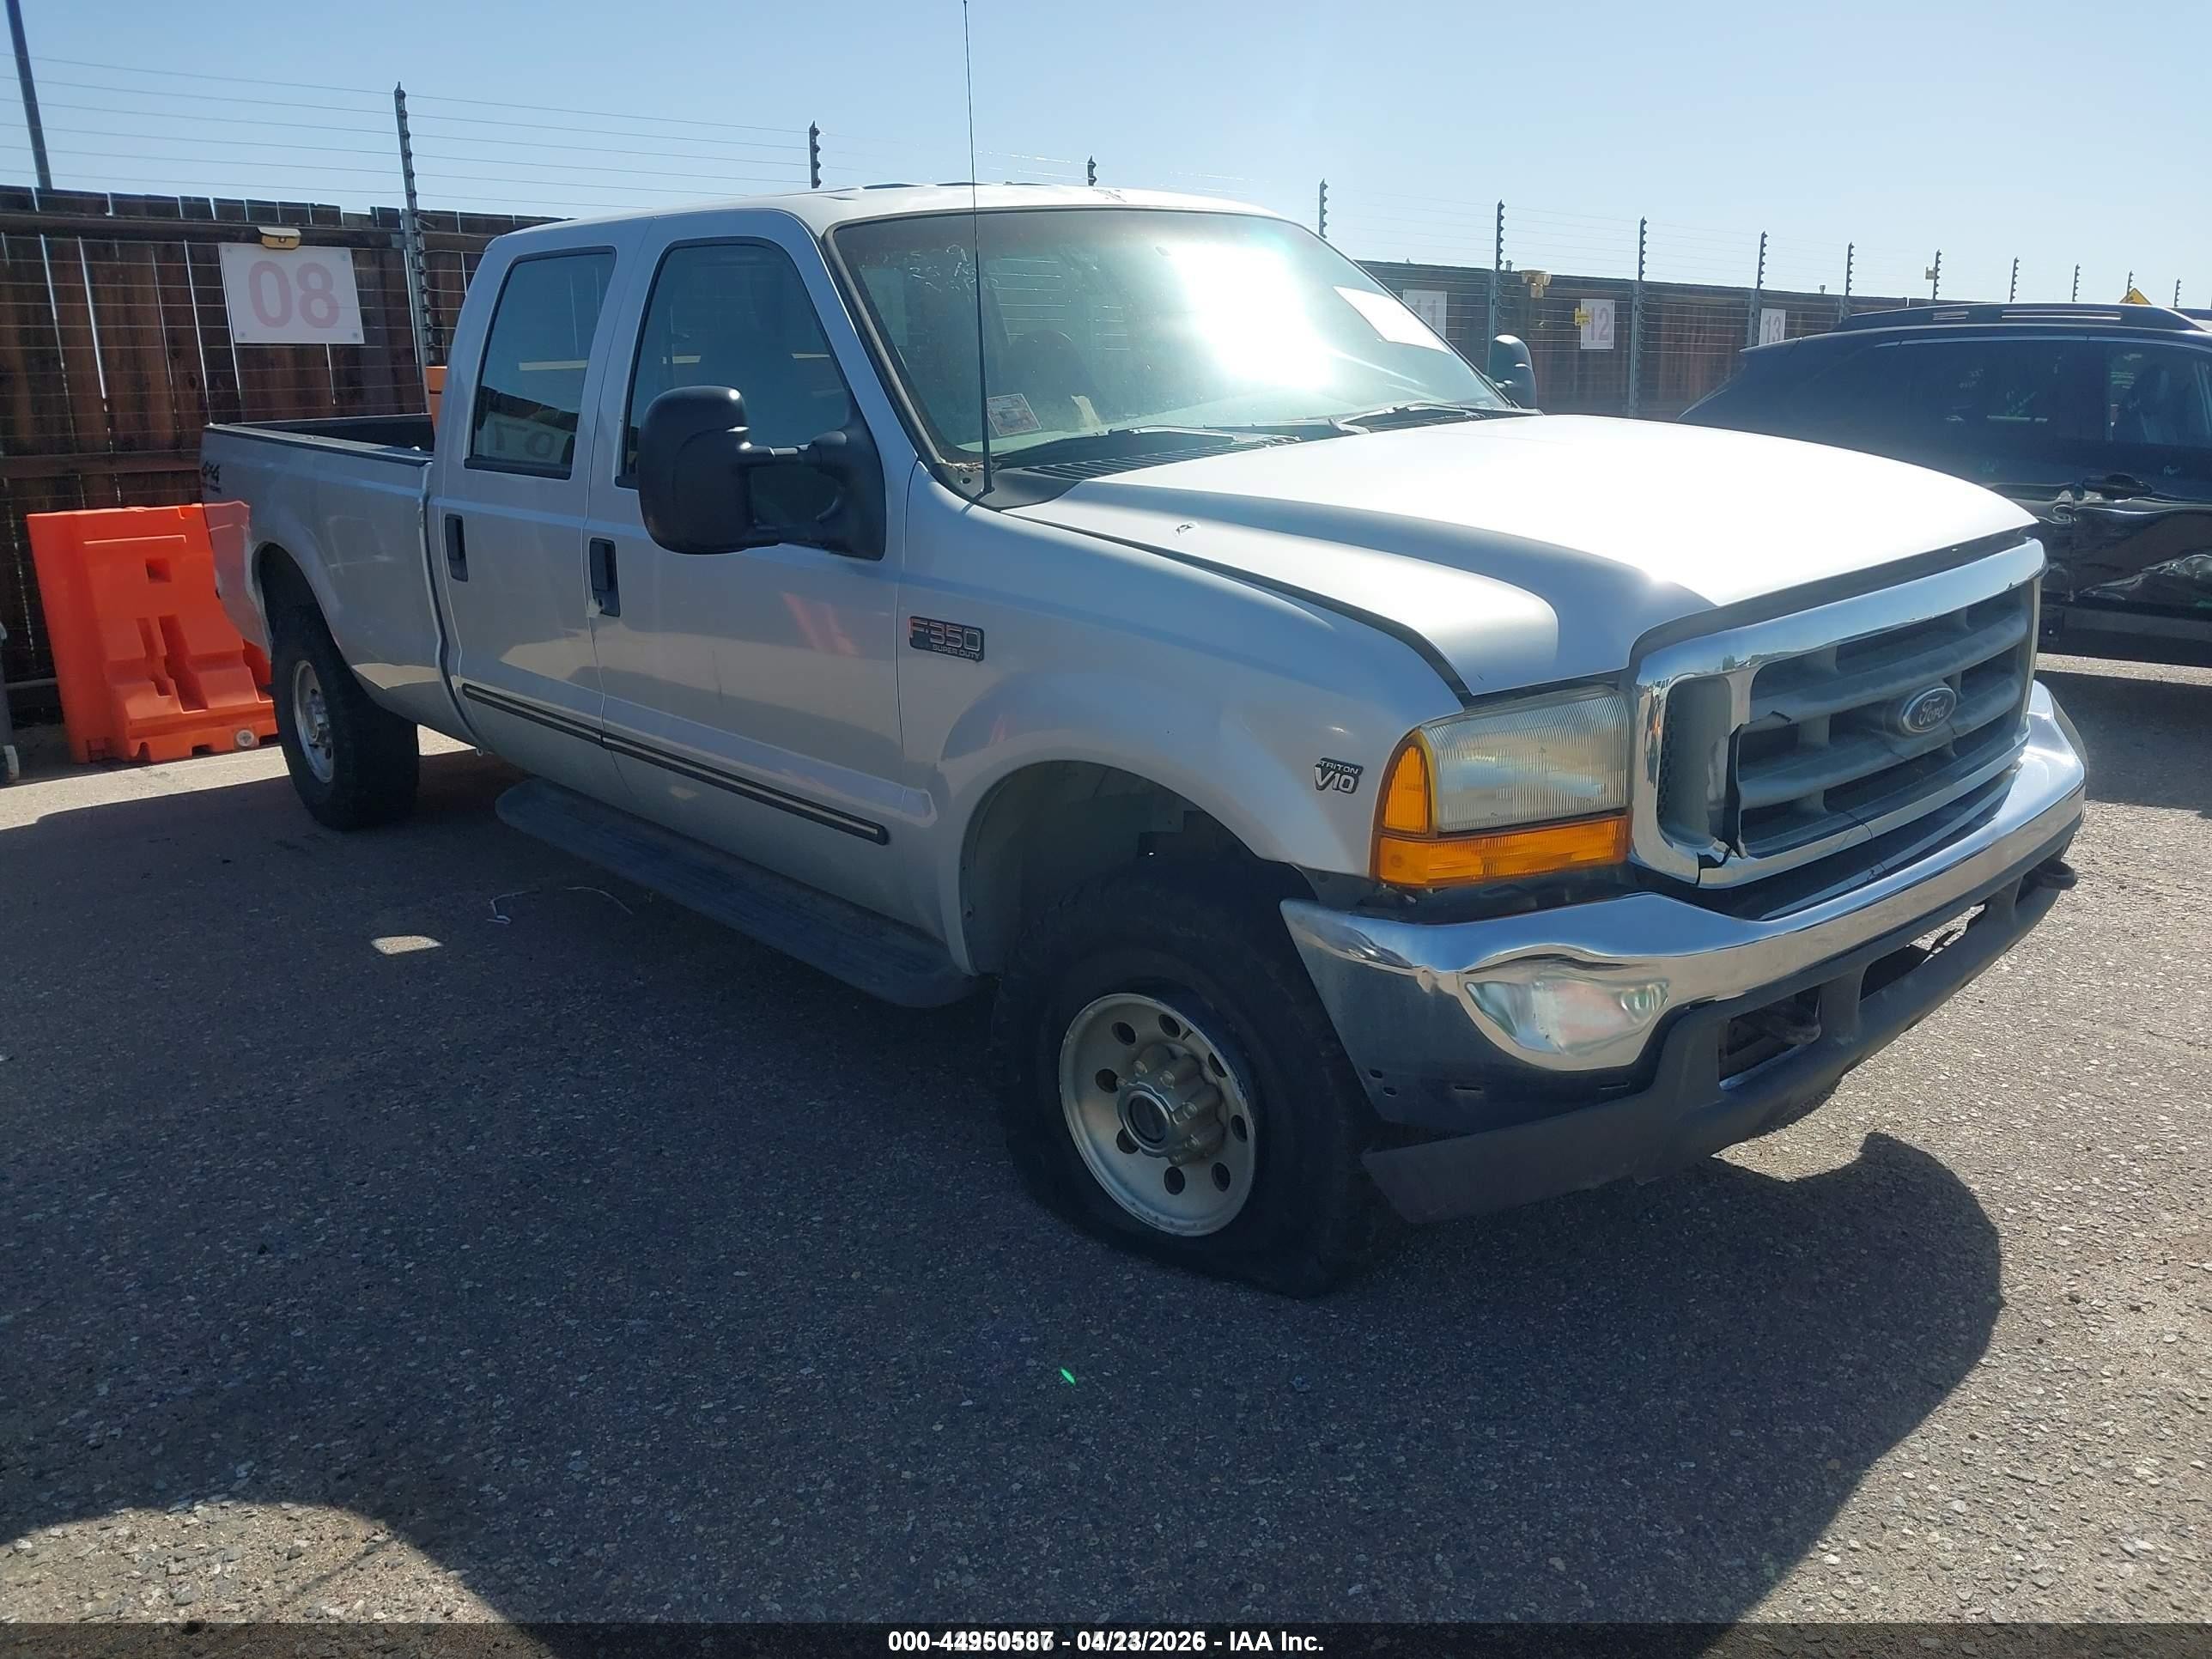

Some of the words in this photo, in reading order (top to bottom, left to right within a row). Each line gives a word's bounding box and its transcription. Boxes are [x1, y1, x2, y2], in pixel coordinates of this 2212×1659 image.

[248, 260, 341, 328] 08
[1588, 307, 1608, 341] 12
[1765, 316, 1781, 342] 13
[933, 644, 958, 655] SUPER
[959, 650, 981, 660] DUTY
[1918, 695, 1948, 726] Ford
[1314, 767, 1355, 793] V10
[1320, 760, 1359, 775] TRITON
